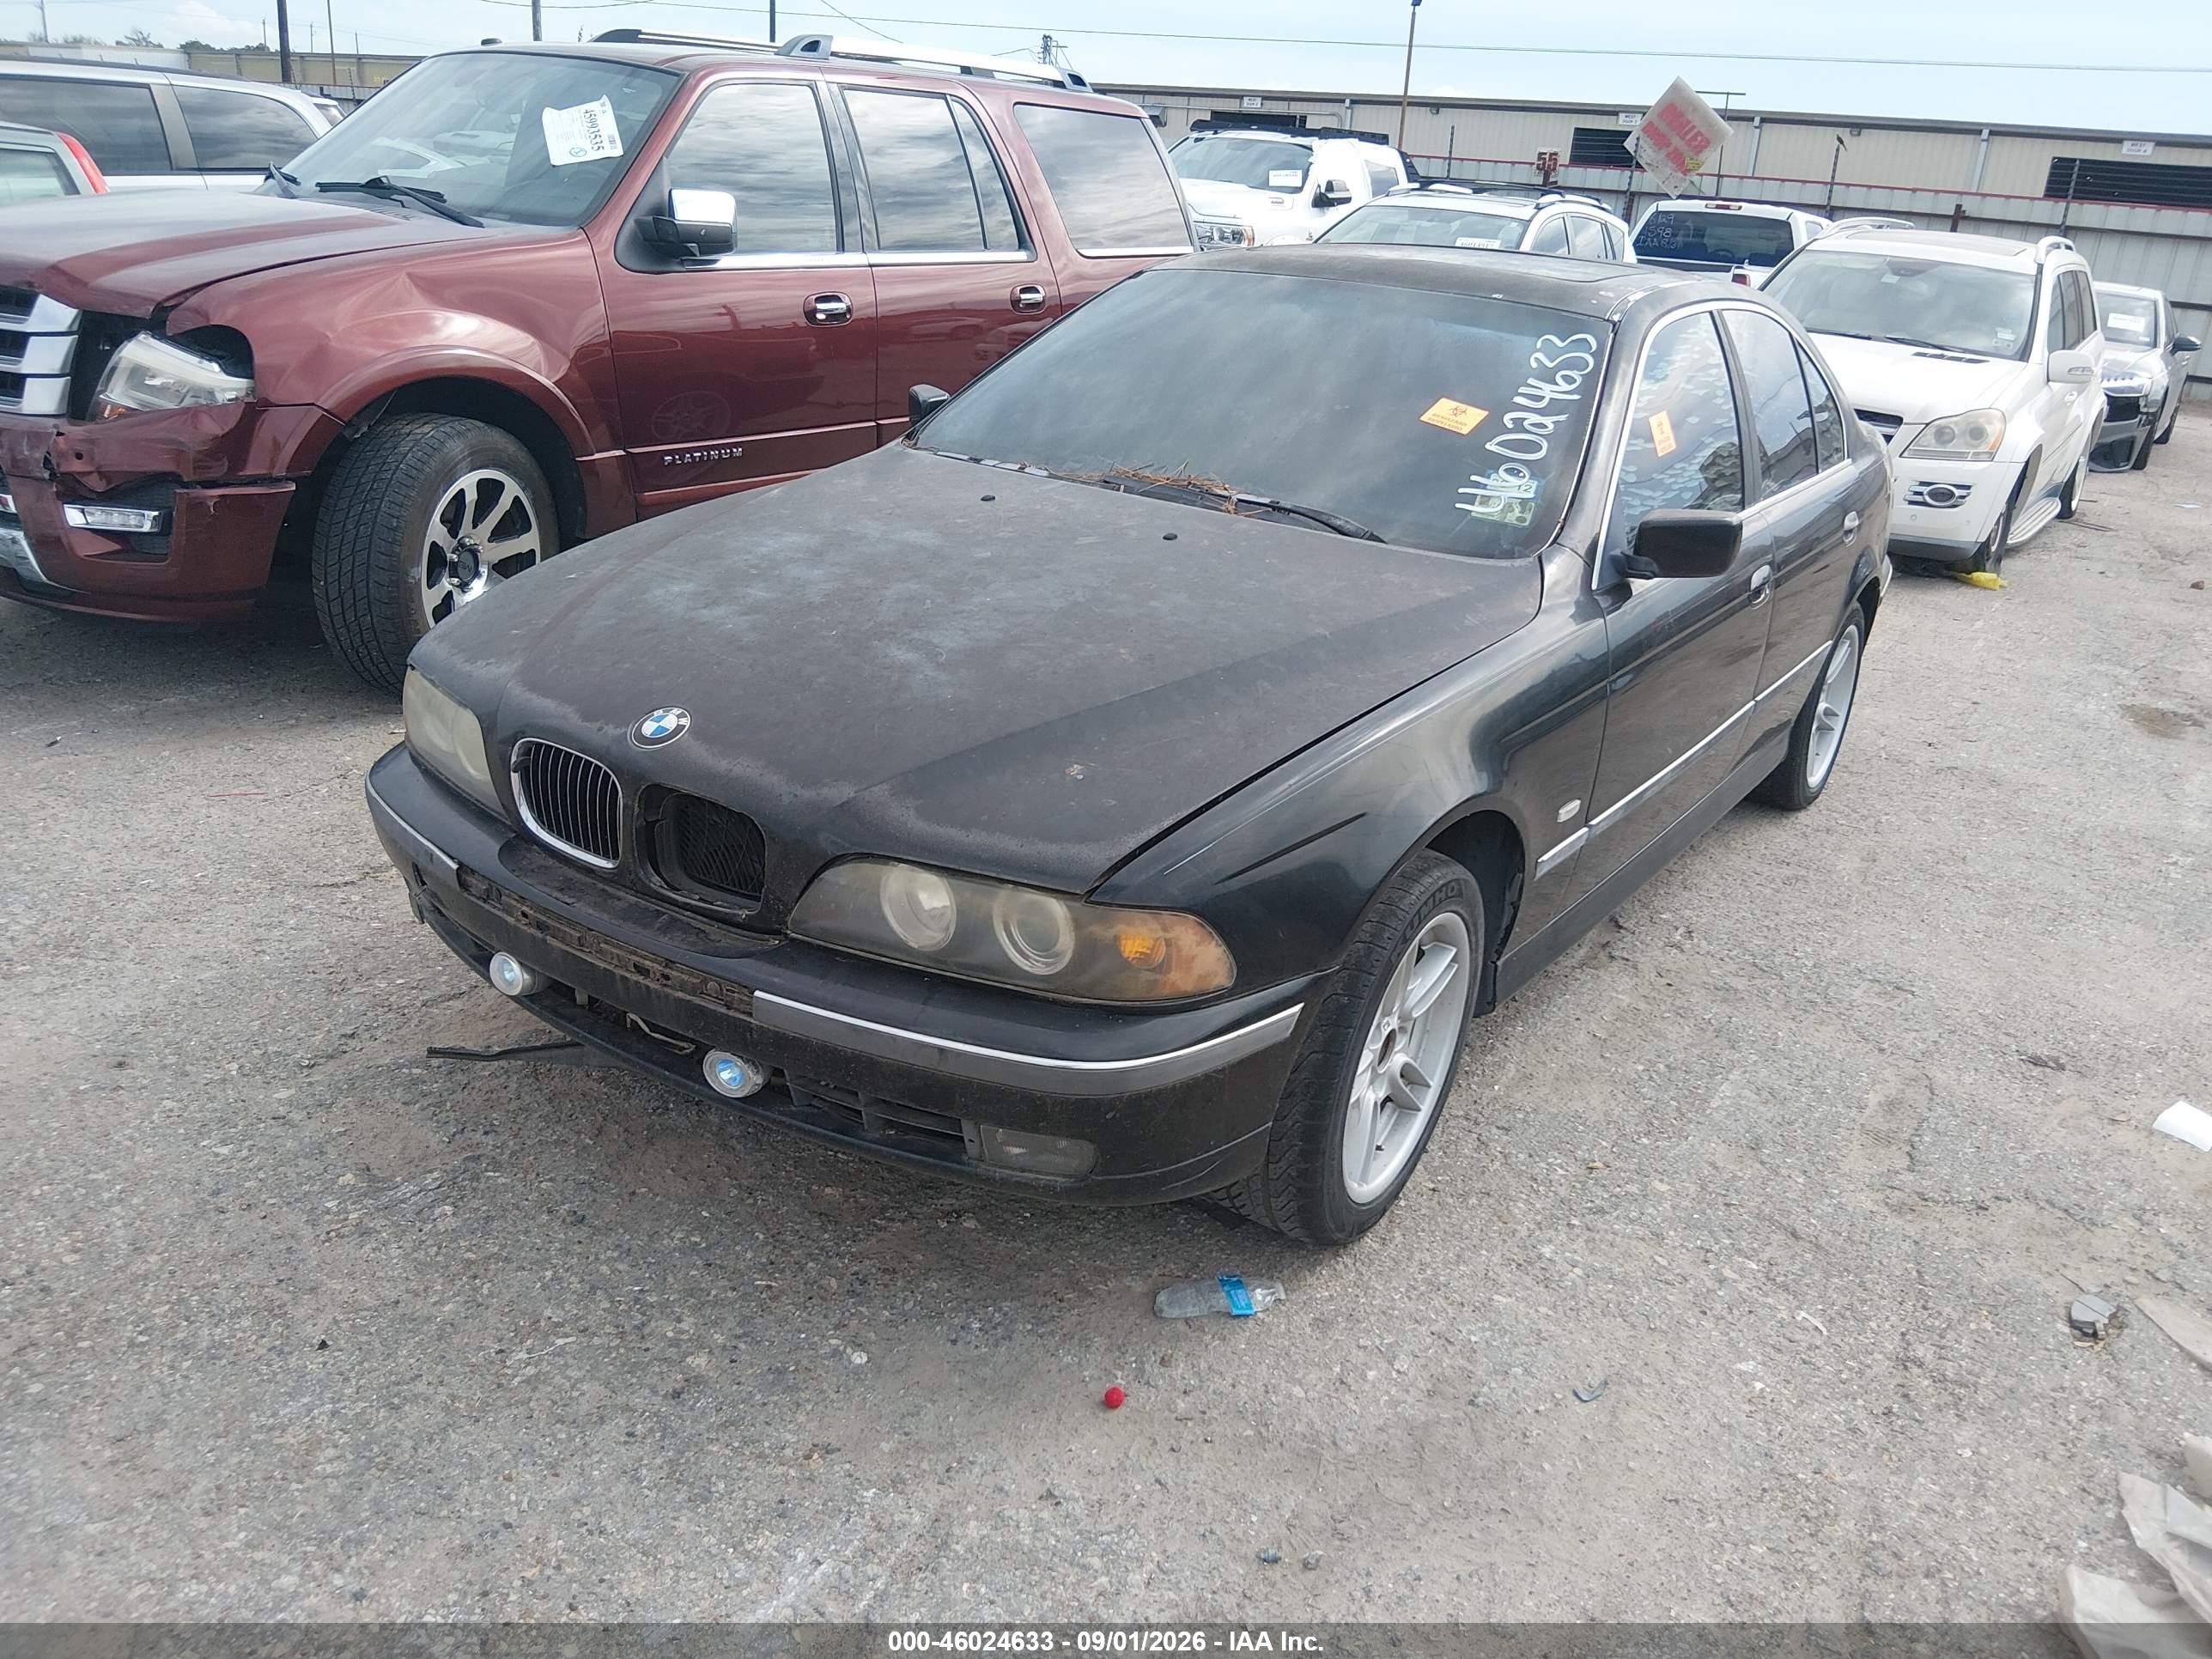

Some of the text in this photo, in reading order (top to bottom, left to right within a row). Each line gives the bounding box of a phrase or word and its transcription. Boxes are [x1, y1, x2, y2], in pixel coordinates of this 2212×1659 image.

[583, 108, 605, 152] 45993535
[1536, 152, 1558, 172] 55
[1455, 333, 1597, 513] 46024633
[664, 447, 742, 466] PLATINUM
